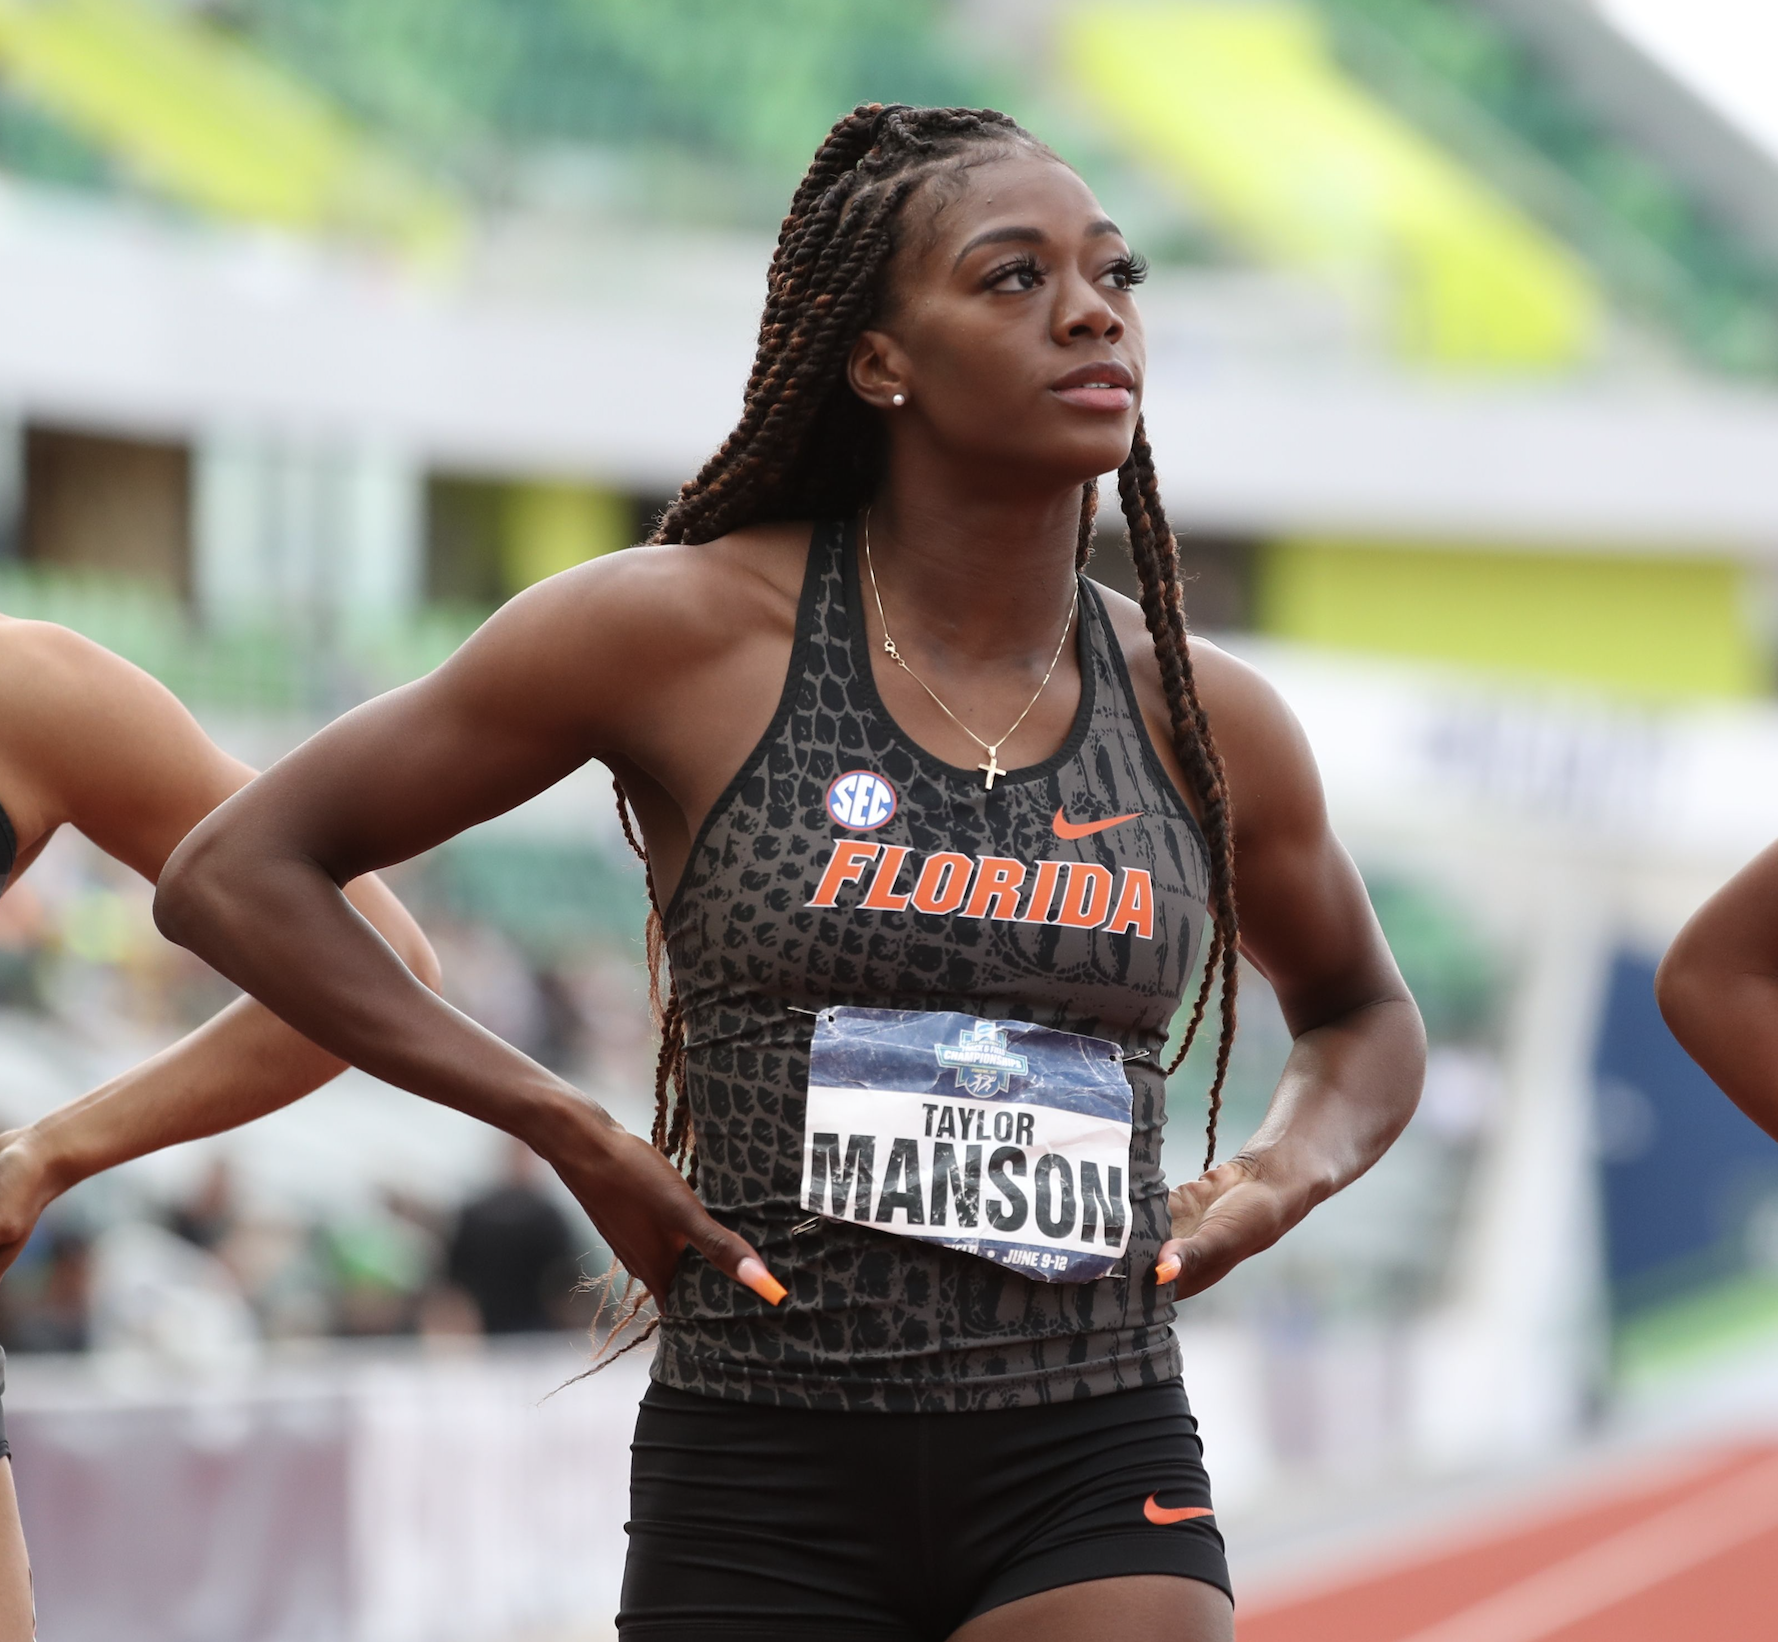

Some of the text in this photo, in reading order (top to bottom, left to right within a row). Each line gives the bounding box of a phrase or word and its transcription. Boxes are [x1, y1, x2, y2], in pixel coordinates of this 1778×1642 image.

[831, 773, 892, 827] SEC
[803, 838, 1155, 940] FLORIDA
[943, 1050, 1022, 1068] CHAMPIONSHIPS
[922, 1103, 1035, 1147] TAYLOR
[808, 1132, 1127, 1248] MANSON
[1002, 1249, 1068, 1271] JUNE 9-12
